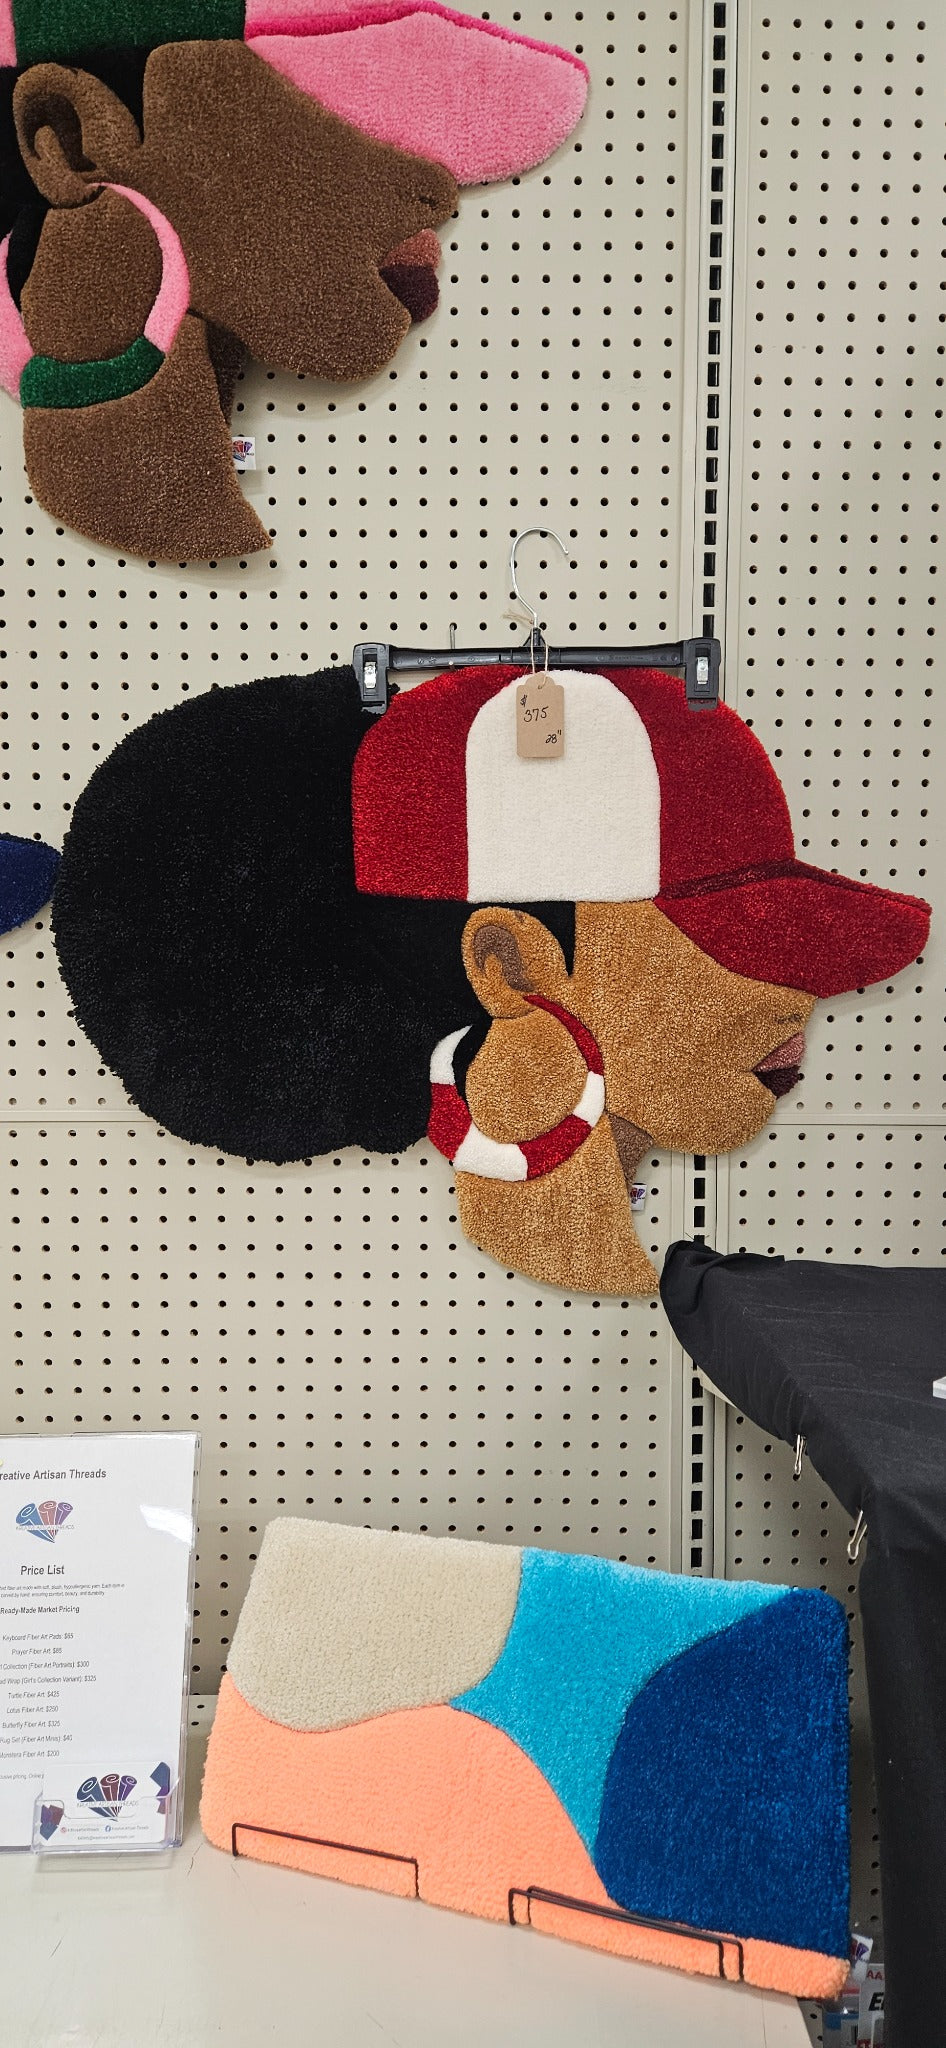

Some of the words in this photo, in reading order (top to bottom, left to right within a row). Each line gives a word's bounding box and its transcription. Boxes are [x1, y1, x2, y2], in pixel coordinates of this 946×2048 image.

[524, 706, 548, 722] 375
[0, 1471, 30, 1480] reative
[33, 1470, 66, 1479] Artisan
[69, 1469, 107, 1478] Threads
[21, 1566, 44, 1576] Price
[48, 1565, 65, 1575] List
[0, 1607, 36, 1615] Ready-Made
[59, 1605, 79, 1613] Pricing
[3, 1634, 26, 1642] Keyboard
[21, 1736, 36, 1744] (Fiber
